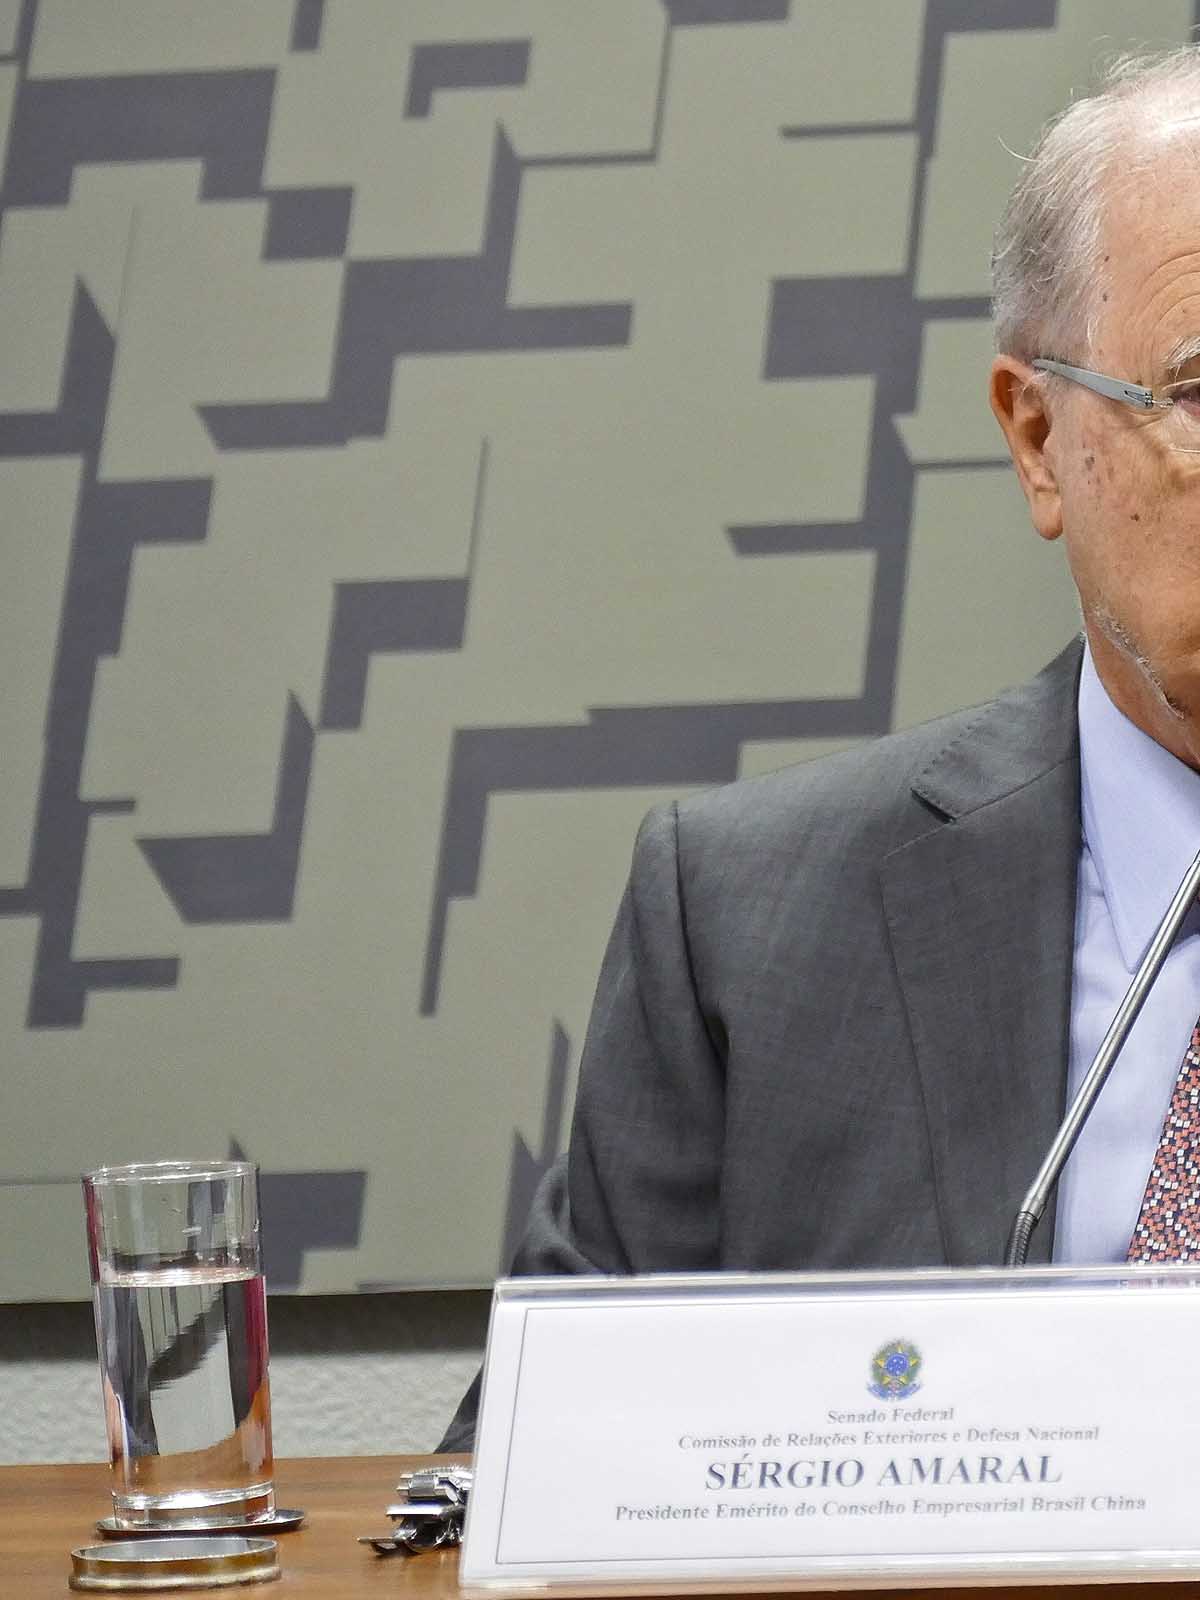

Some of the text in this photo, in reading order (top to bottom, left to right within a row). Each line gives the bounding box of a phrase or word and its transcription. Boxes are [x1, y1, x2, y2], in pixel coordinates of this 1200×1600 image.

[827, 1407, 955, 1425] Senado Federal
[677, 1426, 1100, 1450] Comissão de Relações Exteriores e Defesa Nacional
[705, 1453, 1063, 1490] SÉRGIO AMARAL
[615, 1495, 1147, 1521] Presidente Emérito do Conselho Empresarial Brasil China
